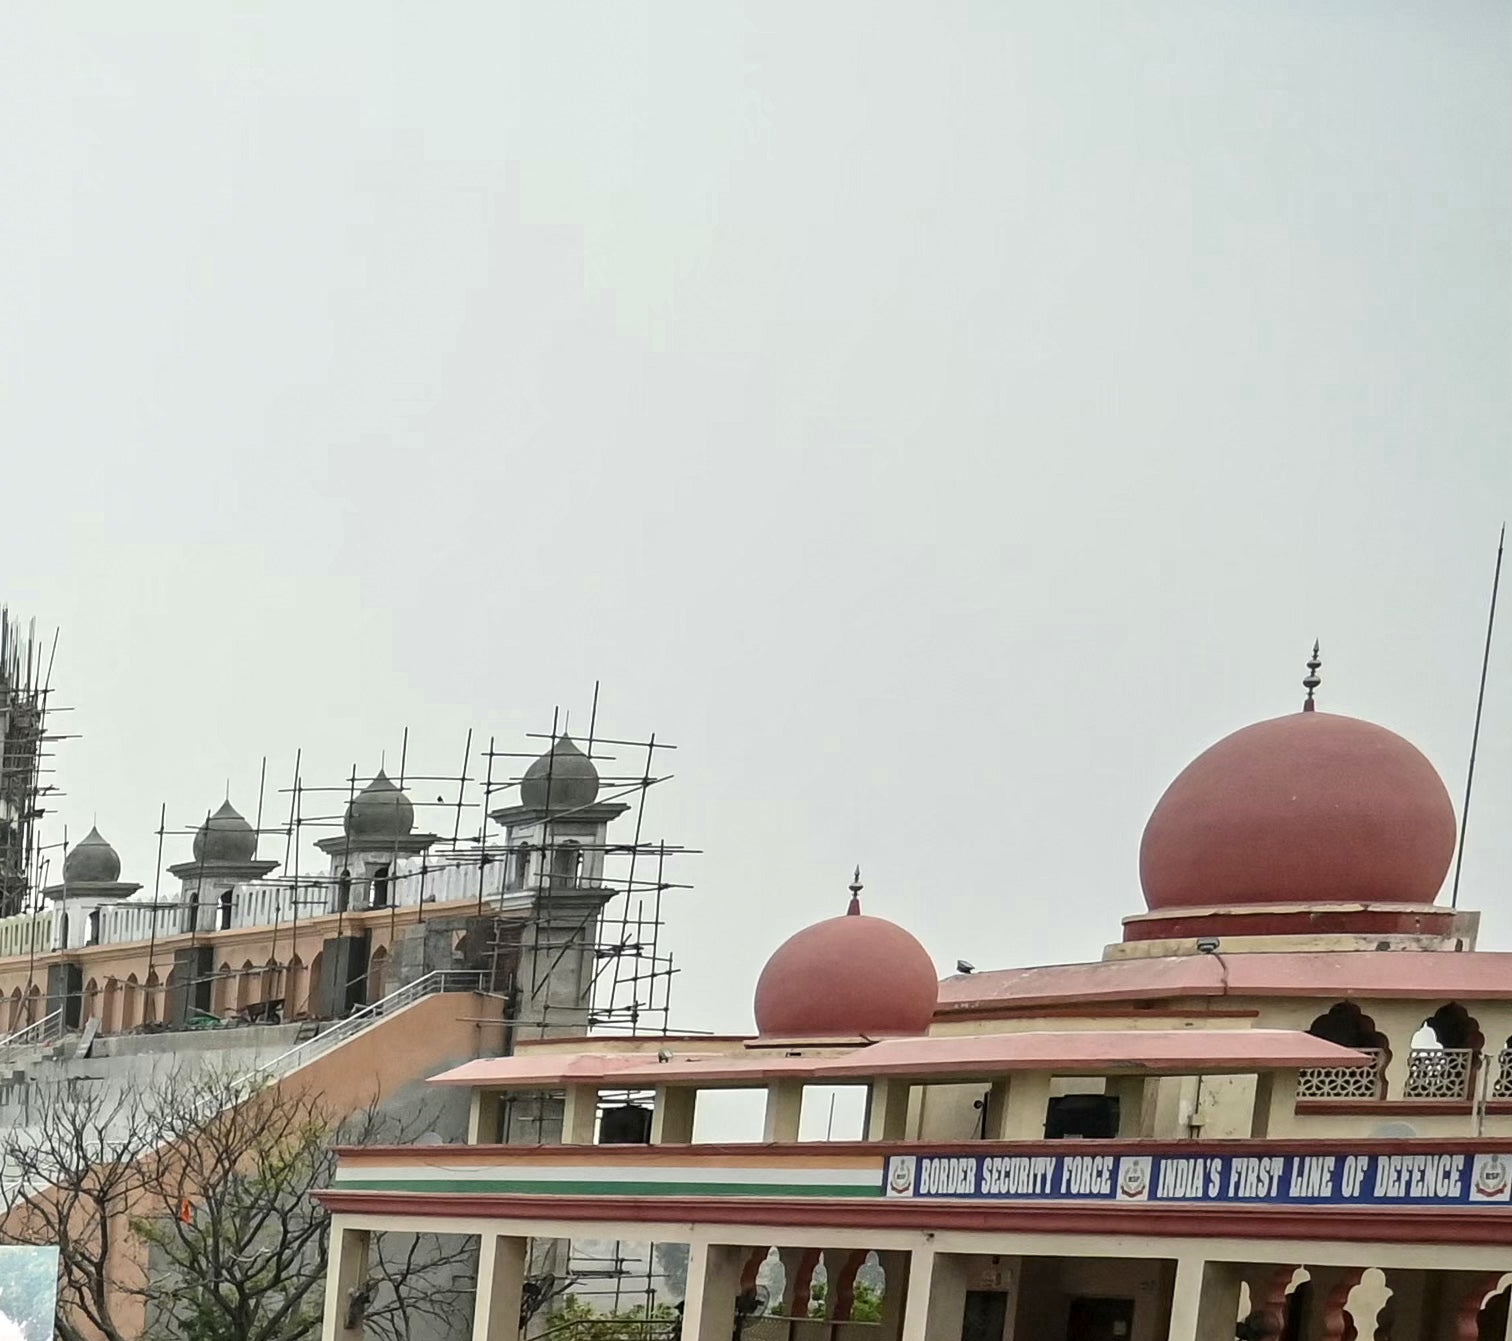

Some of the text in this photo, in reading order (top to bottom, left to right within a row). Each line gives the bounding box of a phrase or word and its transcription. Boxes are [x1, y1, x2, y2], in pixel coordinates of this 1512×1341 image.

[919, 1156, 1114, 1195] BORDER SECURITY FORCE
[1157, 1154, 1465, 1198] INDIA'S FIRST LINE OF DEFENCE
